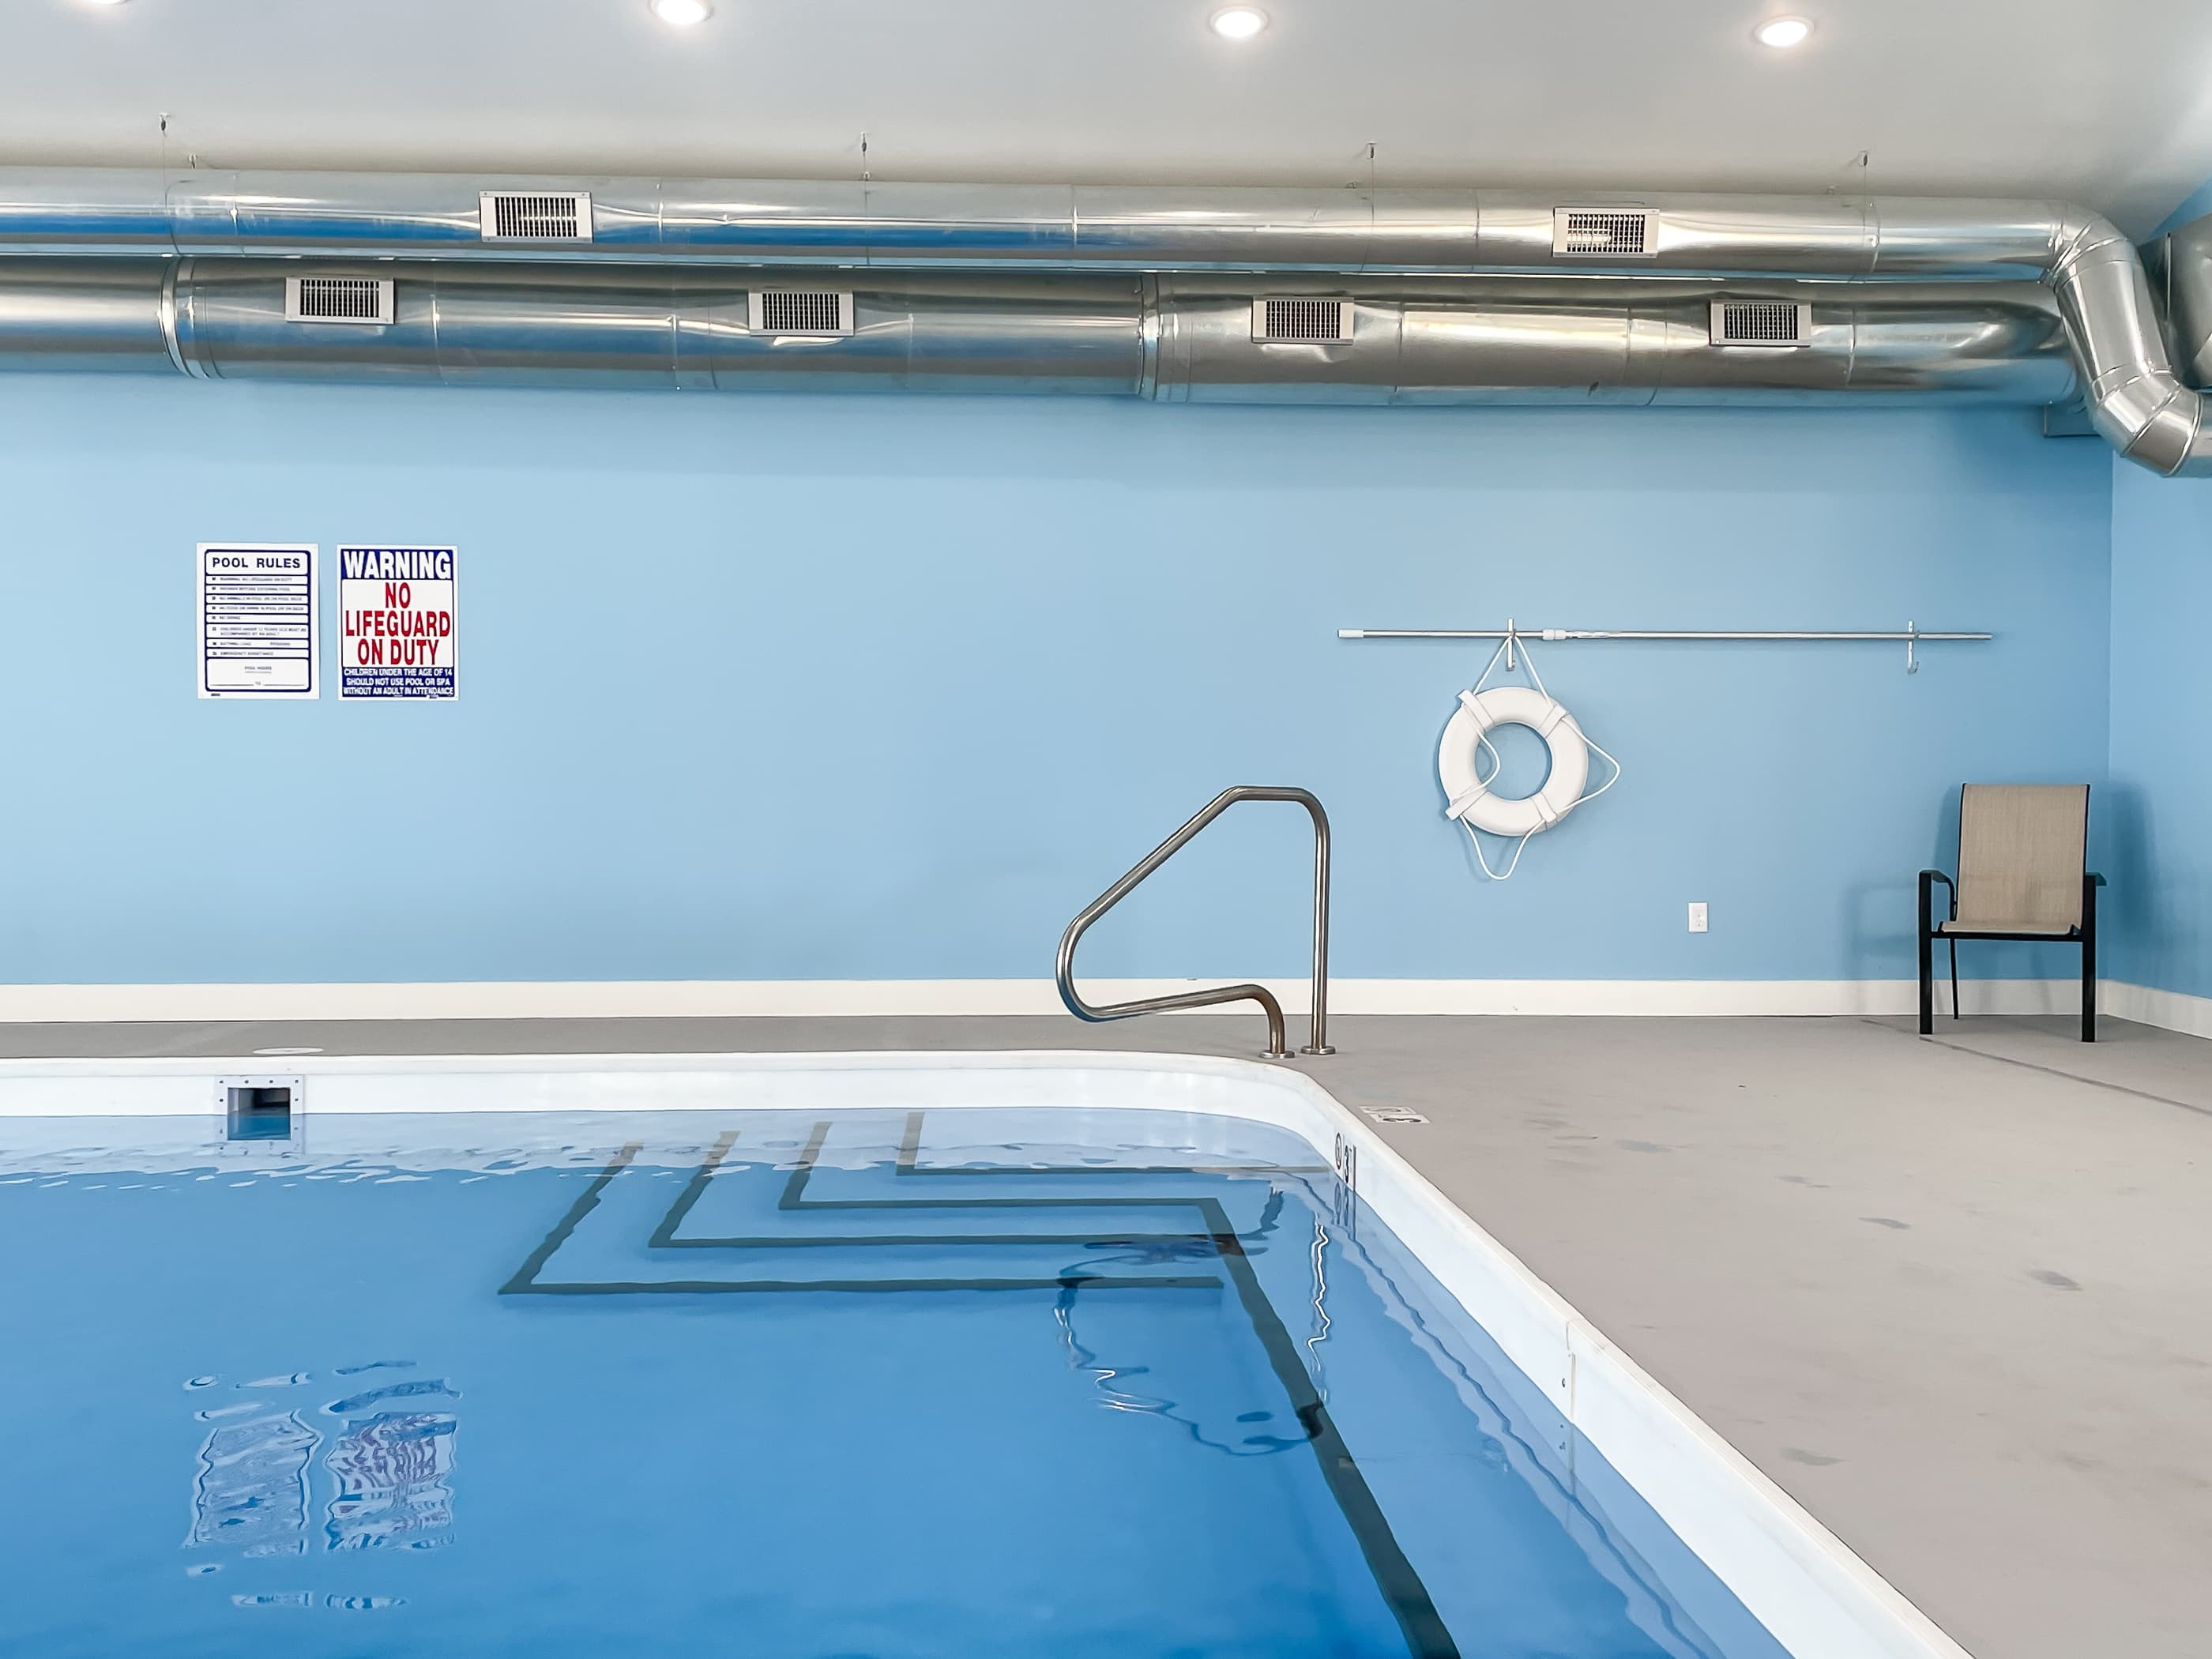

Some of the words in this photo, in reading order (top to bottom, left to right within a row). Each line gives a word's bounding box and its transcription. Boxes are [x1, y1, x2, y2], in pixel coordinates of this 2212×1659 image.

[213, 557, 248, 568] POOL
[257, 558, 301, 569] RULES
[343, 550, 451, 579] WARNING
[385, 581, 411, 608] NO
[345, 610, 450, 637] LIFEGUARD
[357, 638, 383, 665] ON
[390, 639, 439, 665] DUTY
[346, 677, 374, 686] SHOULD
[374, 677, 389, 686] NOT
[383, 687, 404, 695] ADULT
[412, 687, 453, 695] ATTENDANCE
